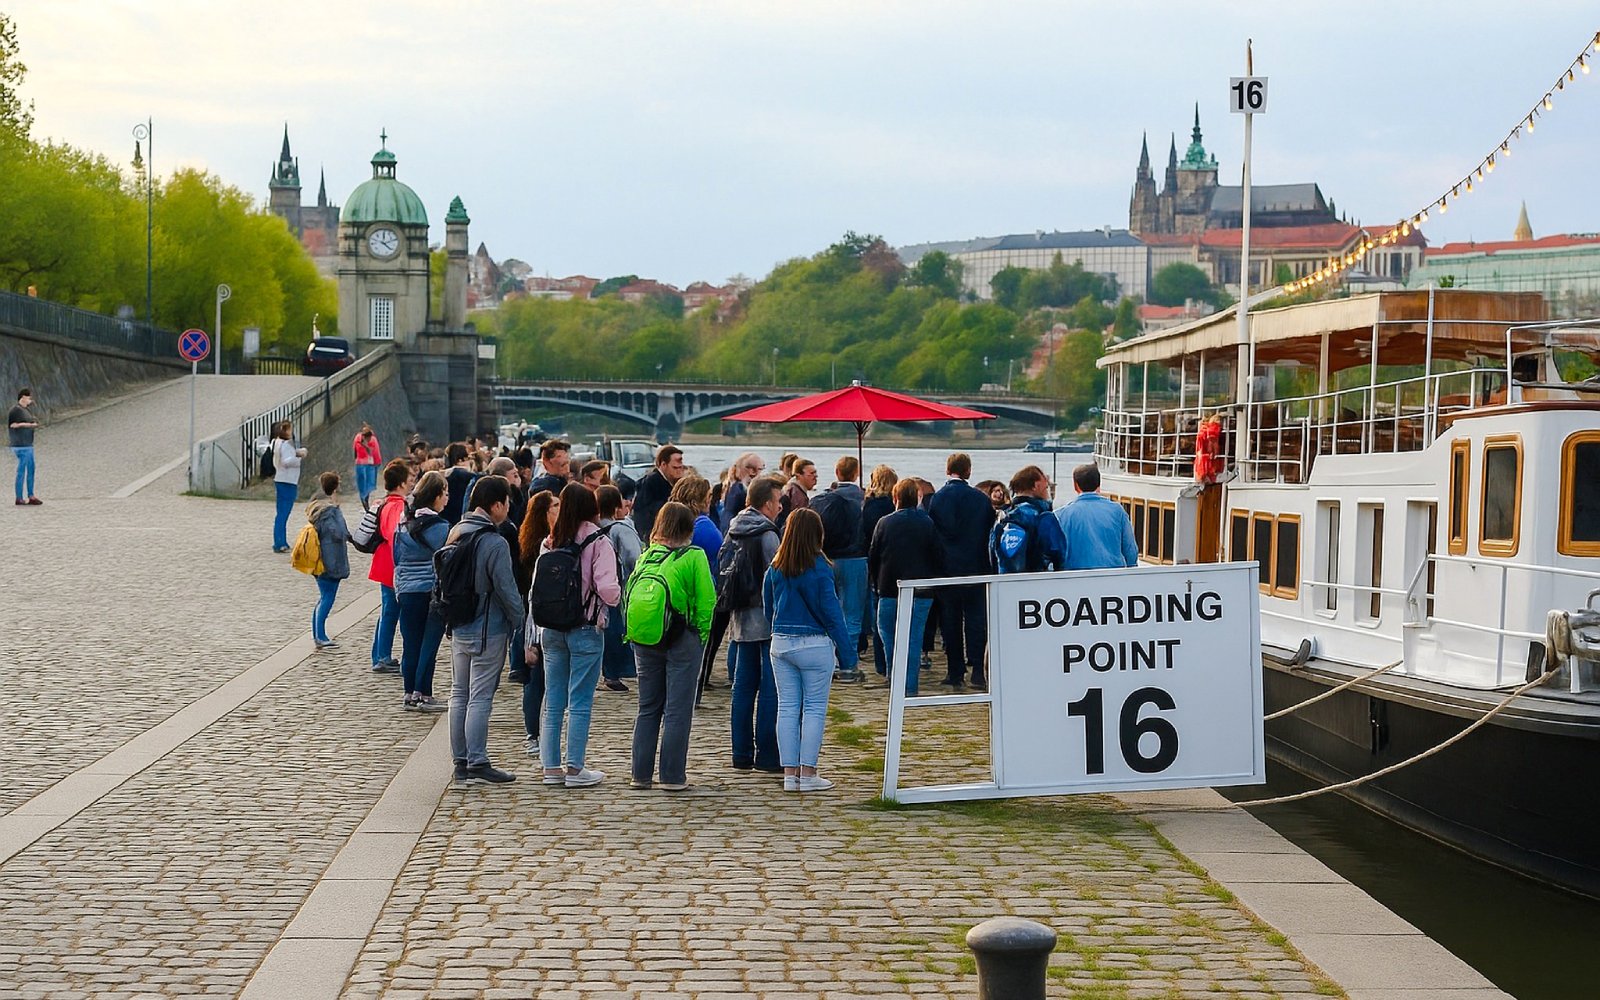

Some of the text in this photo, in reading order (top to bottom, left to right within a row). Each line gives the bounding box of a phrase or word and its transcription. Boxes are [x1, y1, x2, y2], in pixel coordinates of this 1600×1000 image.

[1232, 81, 1263, 110] 16
[1018, 592, 1222, 629] BOARDING
[1063, 640, 1181, 673] POINT
[1067, 687, 1179, 775] 16
